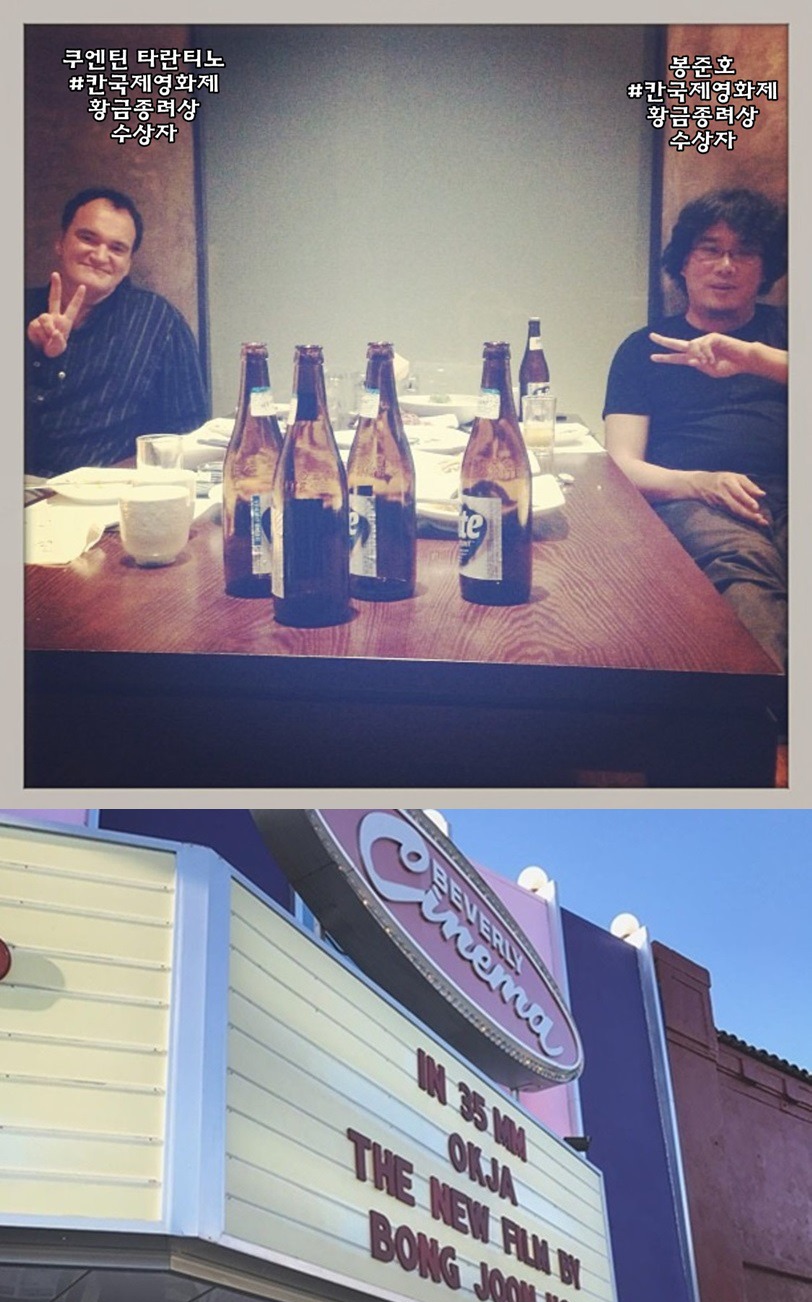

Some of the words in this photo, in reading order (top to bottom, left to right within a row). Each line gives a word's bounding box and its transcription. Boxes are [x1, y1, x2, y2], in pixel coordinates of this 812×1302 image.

[360, 812, 563, 1056] Cinema
[432, 860, 523, 975] BEVERLY
[417, 1048, 447, 1106] IN
[459, 1082, 488, 1132] 35
[492, 1107, 527, 1163] MM
[347, 1128, 416, 1207] THE
[430, 1176, 490, 1244] NEW
[501, 1216, 551, 1275] FILM
[557, 1249, 581, 1290] BY
[448, 1132, 518, 1206] OKJA
[369, 1210, 461, 1289] BONG
